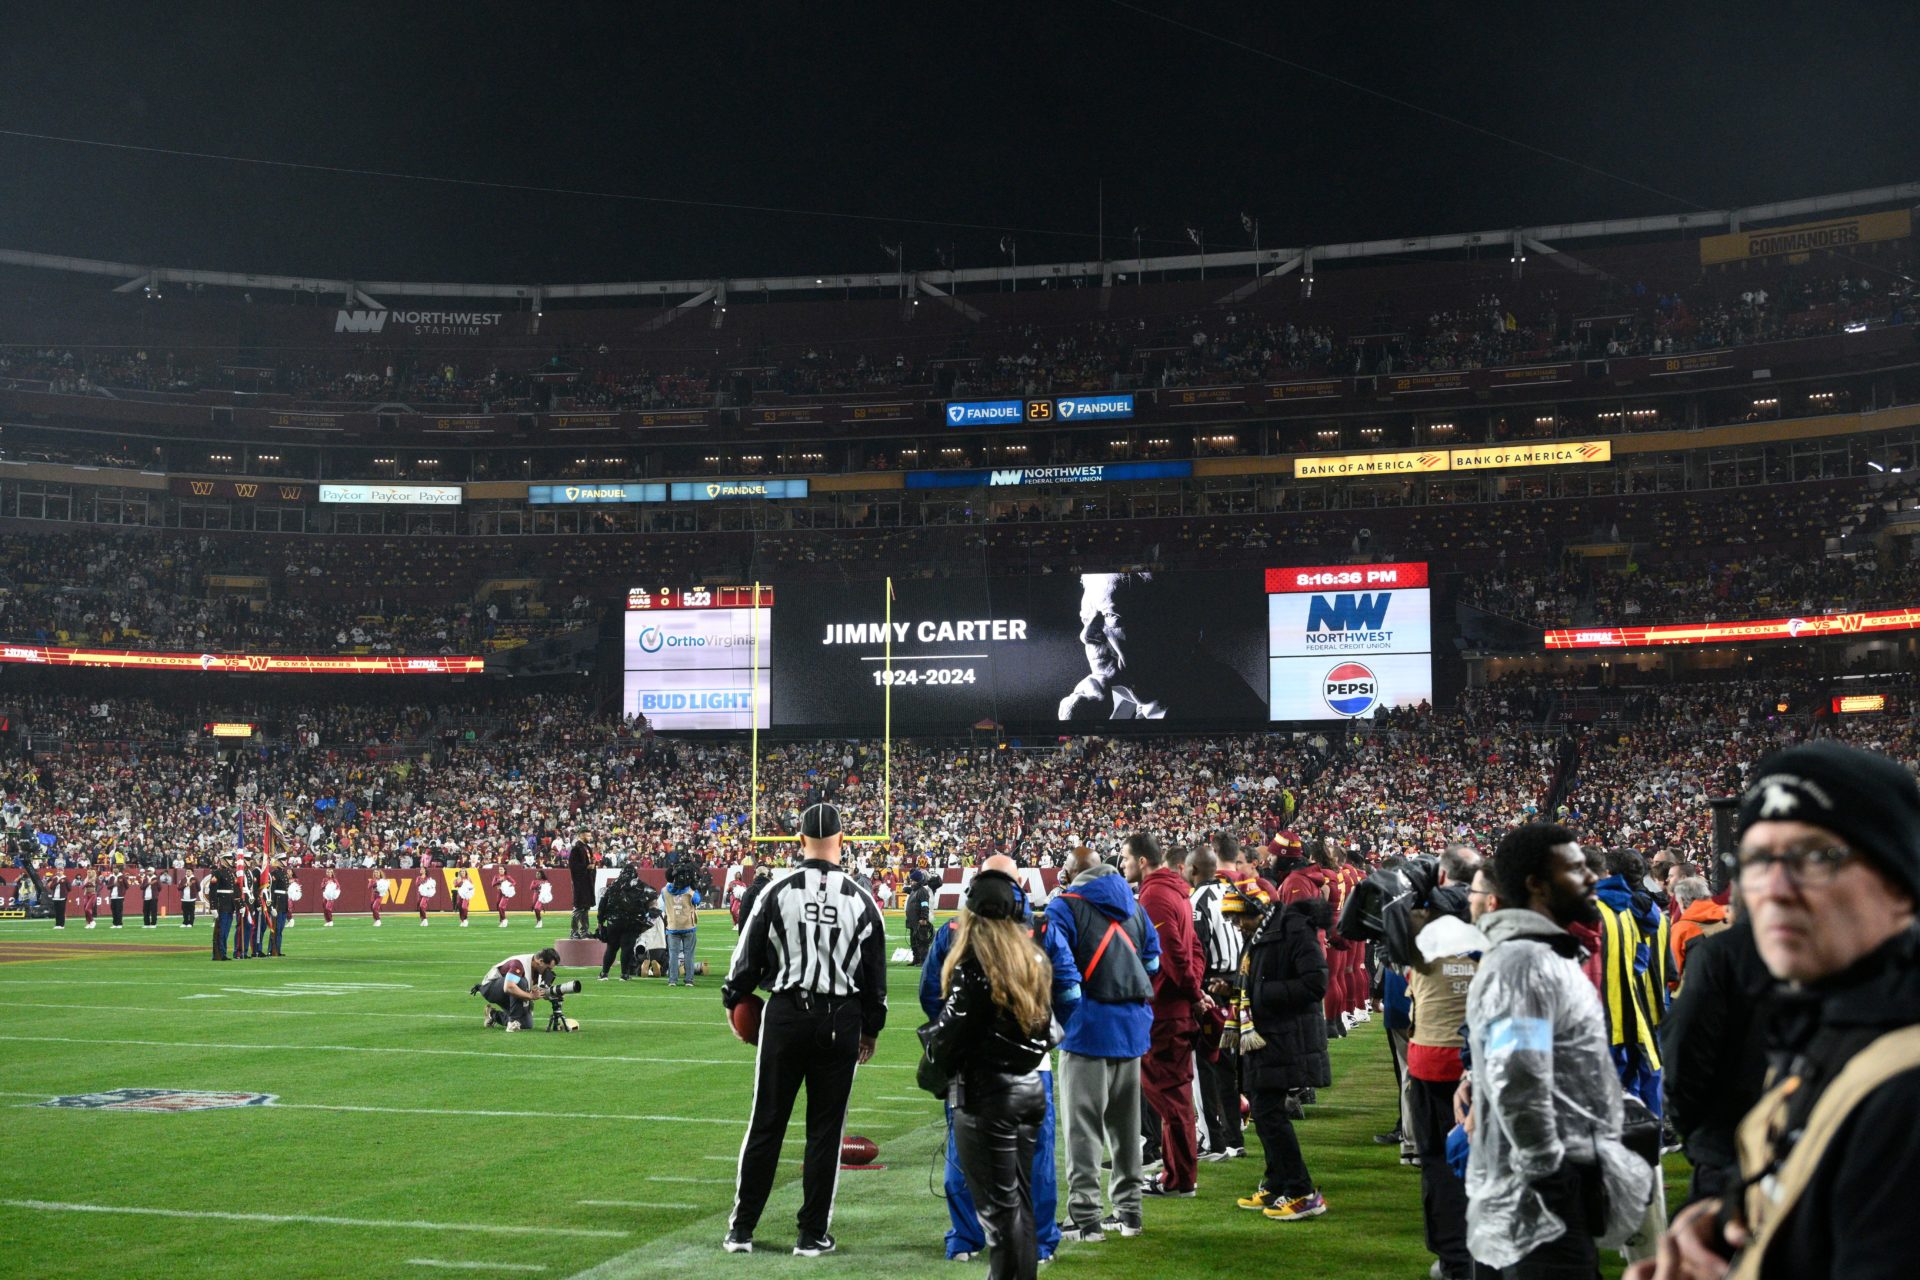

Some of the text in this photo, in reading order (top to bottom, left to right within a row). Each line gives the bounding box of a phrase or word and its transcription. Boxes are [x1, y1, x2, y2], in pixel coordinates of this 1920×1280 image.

[1749, 226, 1860, 256] COMMANDERS
[334, 310, 389, 333] NW
[392, 311, 503, 326] NORTHWEST
[415, 325, 480, 336] STADIUM
[1665, 359, 1680, 371] 80
[967, 407, 1021, 419] FANDUEL
[1030, 403, 1049, 418] 25
[1077, 401, 1131, 414] FANDUEL
[1457, 451, 1573, 466] BANK OF AMERICA
[1024, 465, 1104, 478] NORTHWEST
[1302, 460, 1413, 474] BANK OF AMERICA
[1080, 475, 1102, 483] UNION
[323, 489, 460, 504] Paycor Paycor Paycor
[582, 488, 627, 499] FANDUEL
[722, 485, 768, 497] FANDUEL
[1296, 570, 1397, 586] 8:16:36 PM
[661, 587, 669, 595] 0
[661, 598, 669, 606] 0
[683, 592, 711, 606] 5:23
[1306, 592, 1392, 632] NW
[823, 619, 1027, 644] JIMMY CARTER
[1719, 626, 1779, 635] FALCONS
[1813, 621, 1831, 630] VS
[667, 634, 756, 648] OrthoVirginia
[1306, 631, 1393, 644] NORTHWEST
[139, 657, 193, 665] FALCONS
[224, 658, 240, 667] VS
[276, 660, 352, 668] COMMANDERS
[873, 668, 976, 686] 1924-2024
[1327, 683, 1374, 695] PEPSI
[642, 692, 751, 709] BUD LIGHT
[1559, 712, 1573, 720] 234
[804, 902, 838, 925] 89
[1442, 963, 1476, 976] MEDIA
